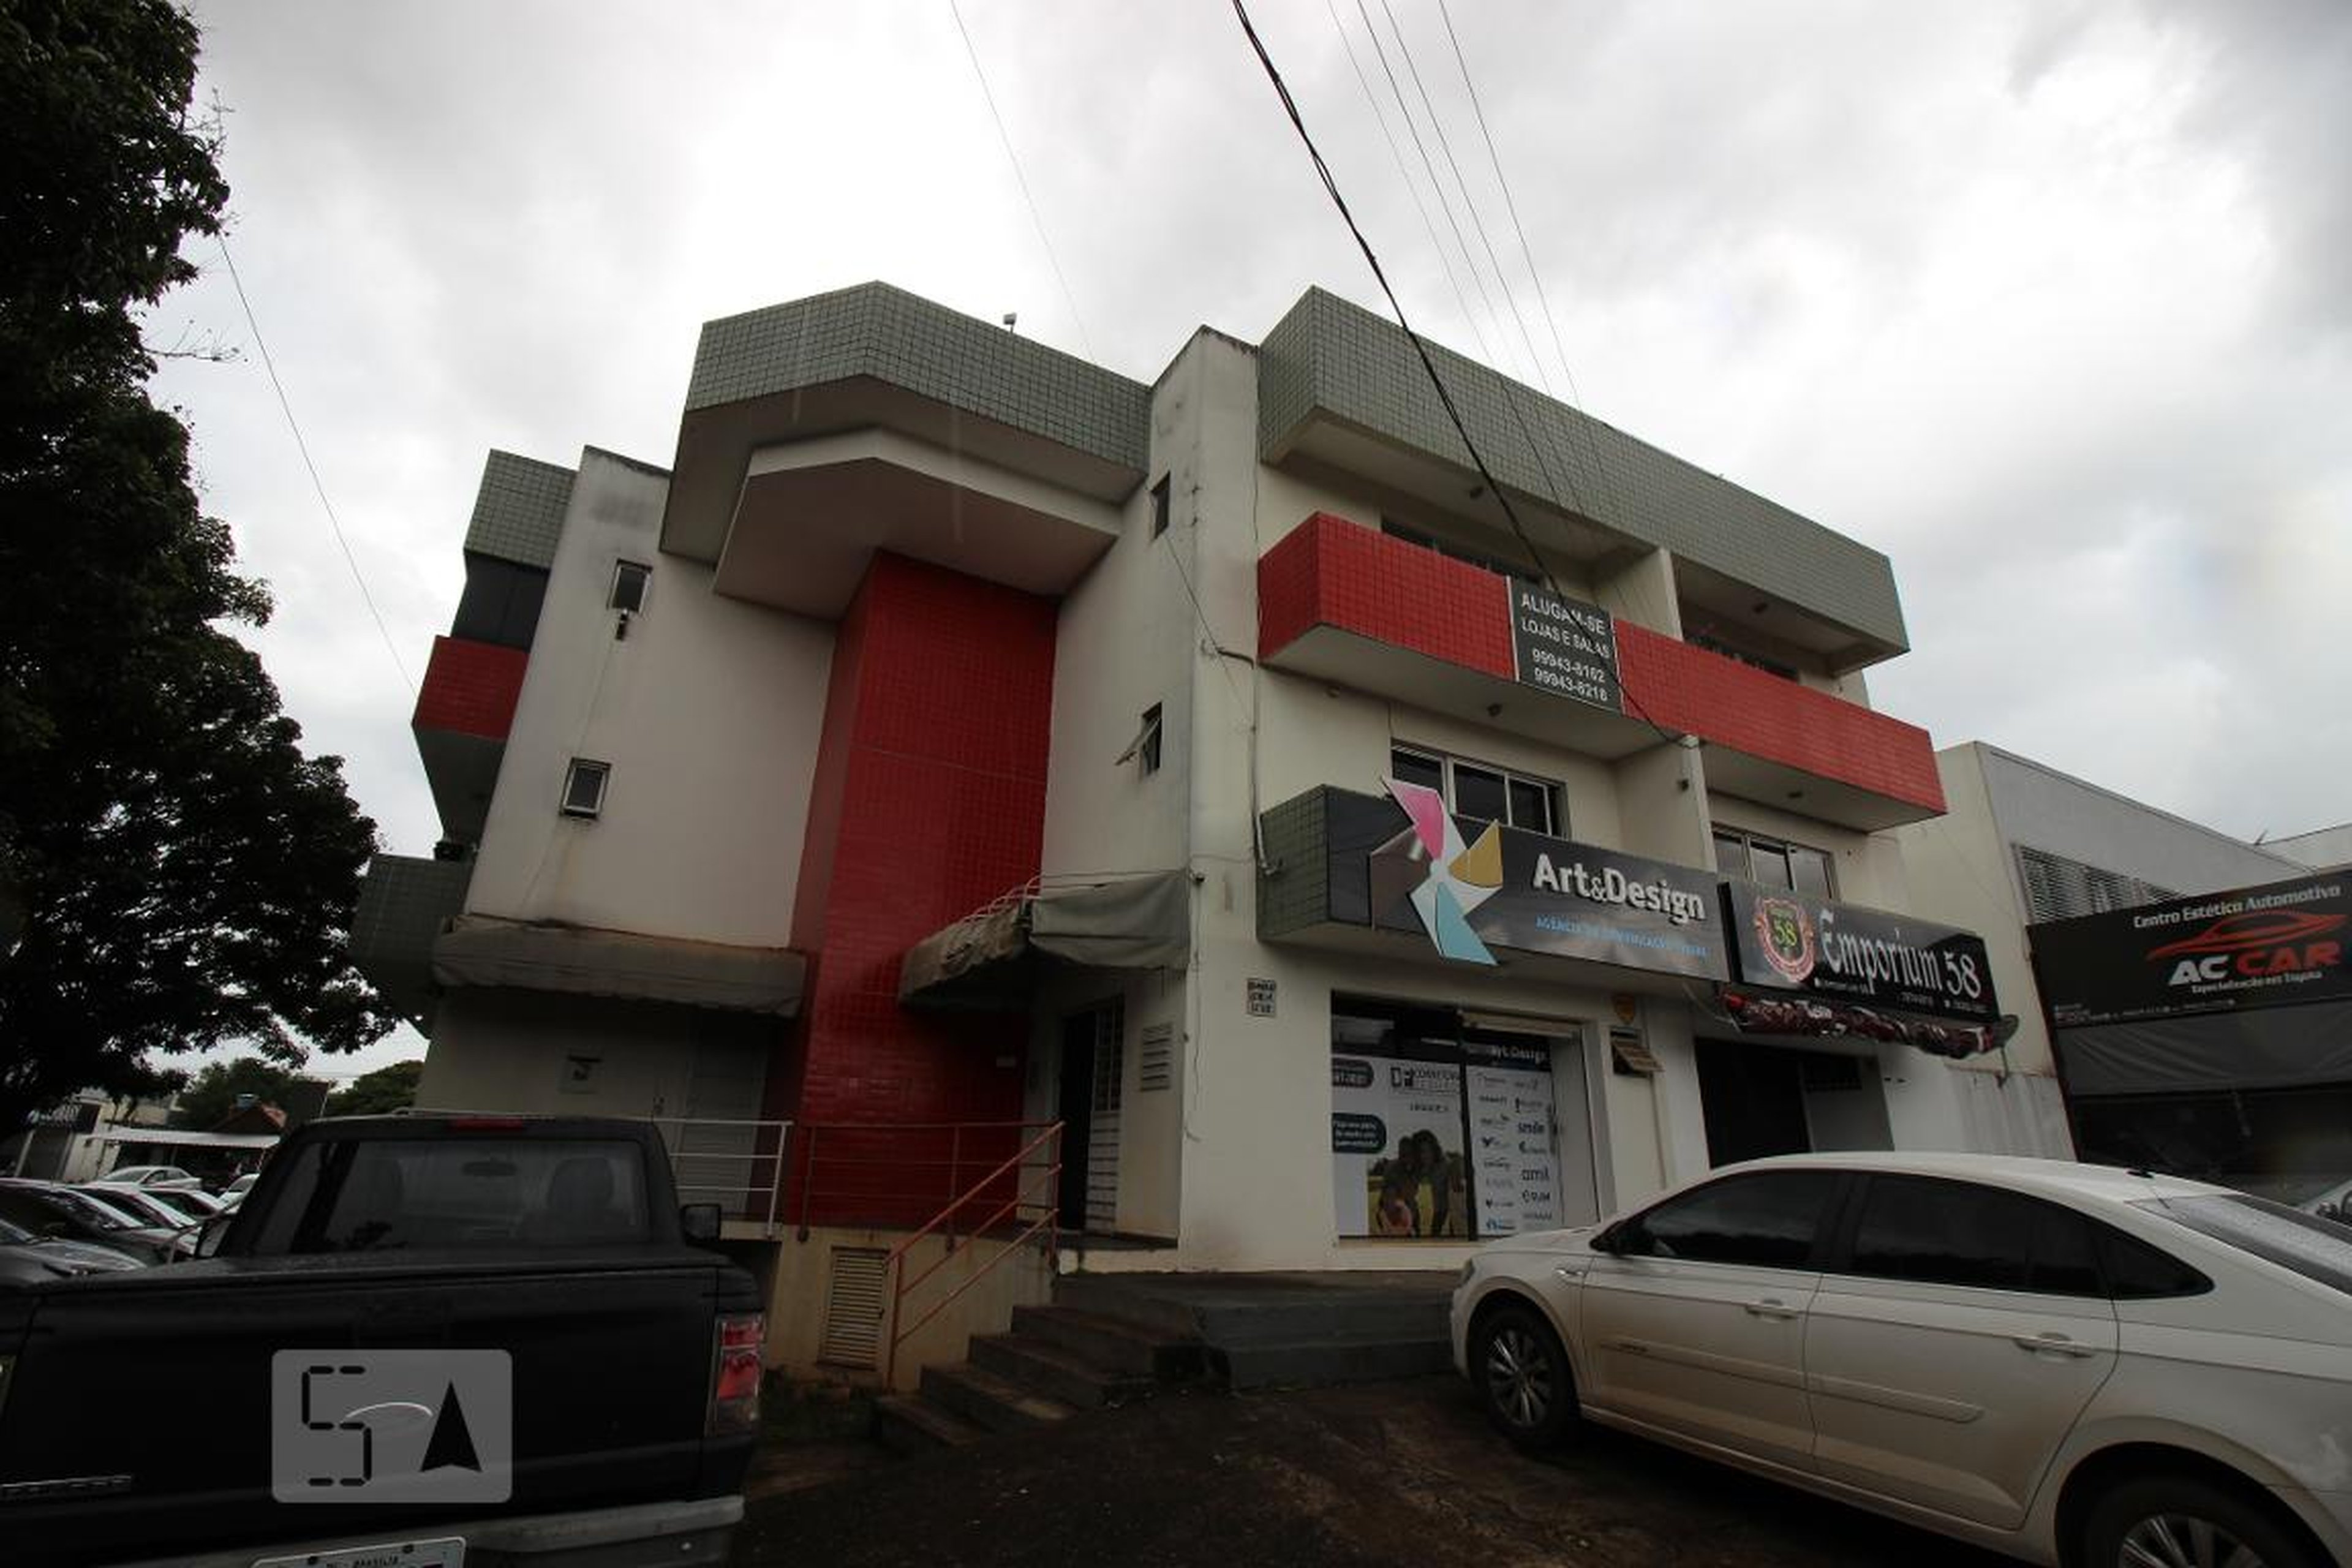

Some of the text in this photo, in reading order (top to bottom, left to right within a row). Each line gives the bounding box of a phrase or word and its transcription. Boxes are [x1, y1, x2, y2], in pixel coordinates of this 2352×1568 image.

[1521, 592, 1605, 635] ALUGAM-SE
[1522, 617, 1559, 642] LOJAS
[1562, 631, 1570, 646] E
[1533, 853, 1706, 924] Art&Design
[2134, 910, 2180, 929] Centro
[1819, 909, 1982, 1000] Emporium 58
[2168, 941, 2343, 986] AC CAR
